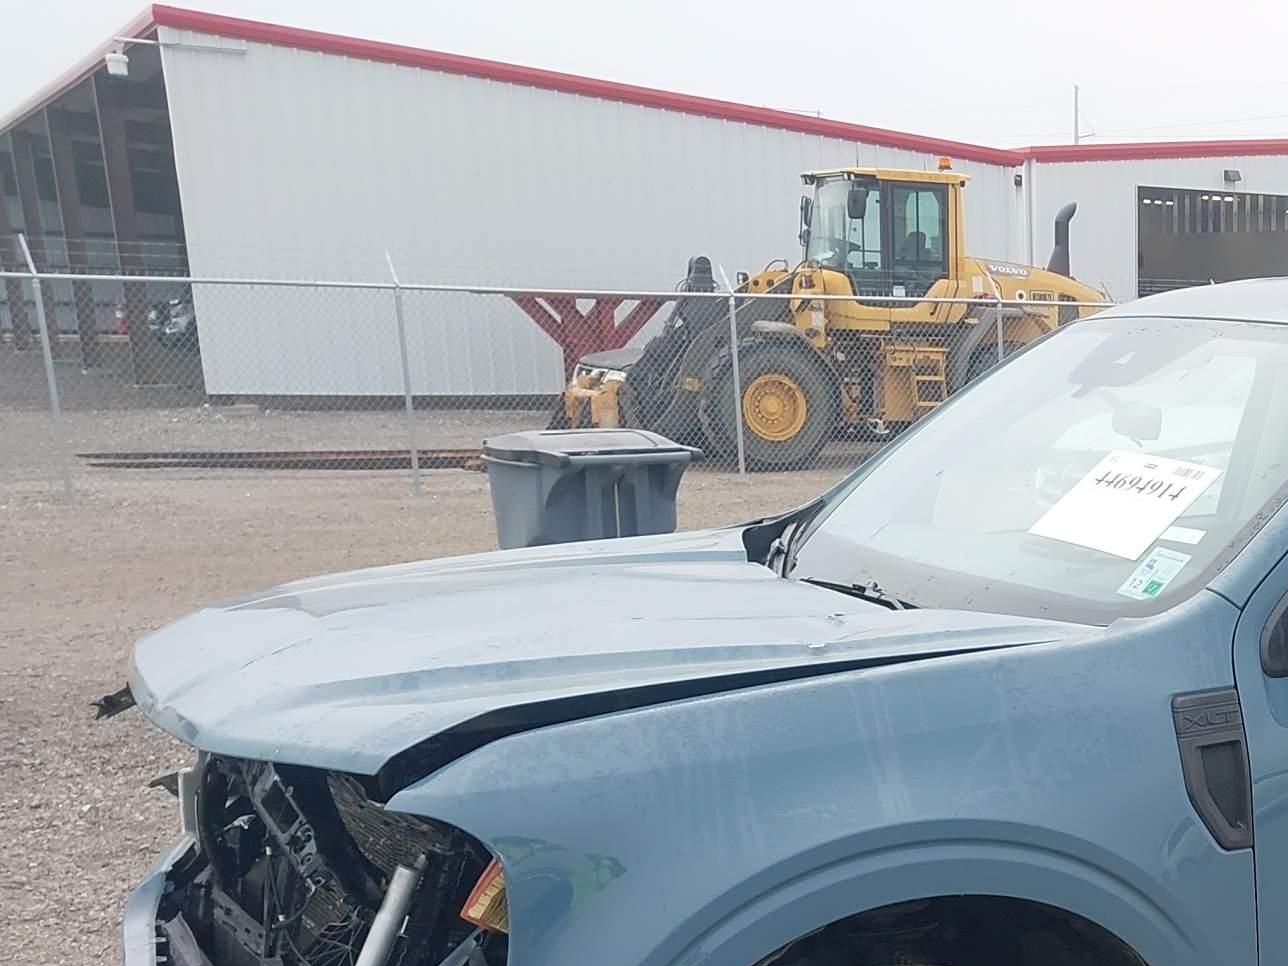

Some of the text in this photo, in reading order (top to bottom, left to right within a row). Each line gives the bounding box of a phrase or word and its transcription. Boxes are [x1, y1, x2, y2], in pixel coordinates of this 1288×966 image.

[988, 264, 1028, 276] VOLVO
[1095, 470, 1188, 502] 44694914
[1128, 578, 1144, 590] 12
[1183, 710, 1239, 730] XLT
